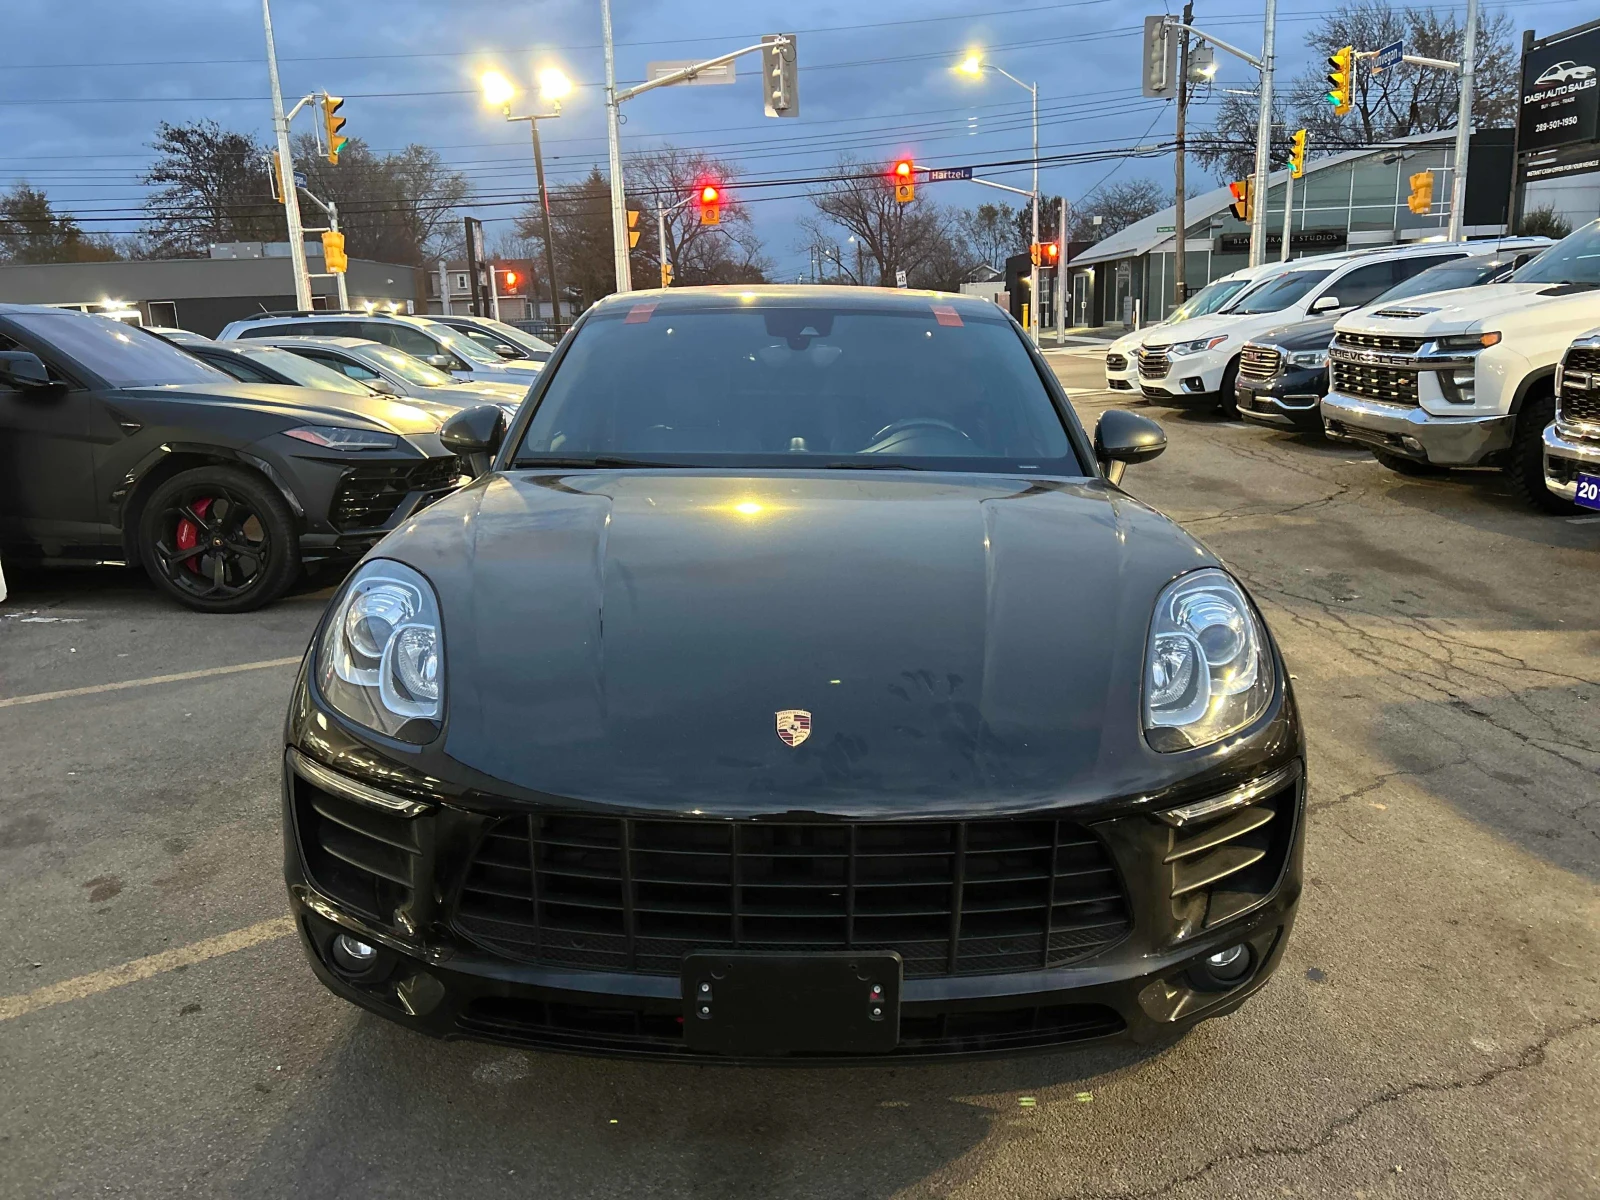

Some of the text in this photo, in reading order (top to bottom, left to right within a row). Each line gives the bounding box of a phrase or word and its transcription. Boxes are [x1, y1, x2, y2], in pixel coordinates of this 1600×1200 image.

[1524, 78, 1597, 105] DASH AUTO SALES
[1535, 116, 1578, 132] 289-501-1950
[932, 170, 964, 179] Hartzel
[1299, 234, 1338, 242] STUDIOS
[1578, 482, 1600, 500] 20
